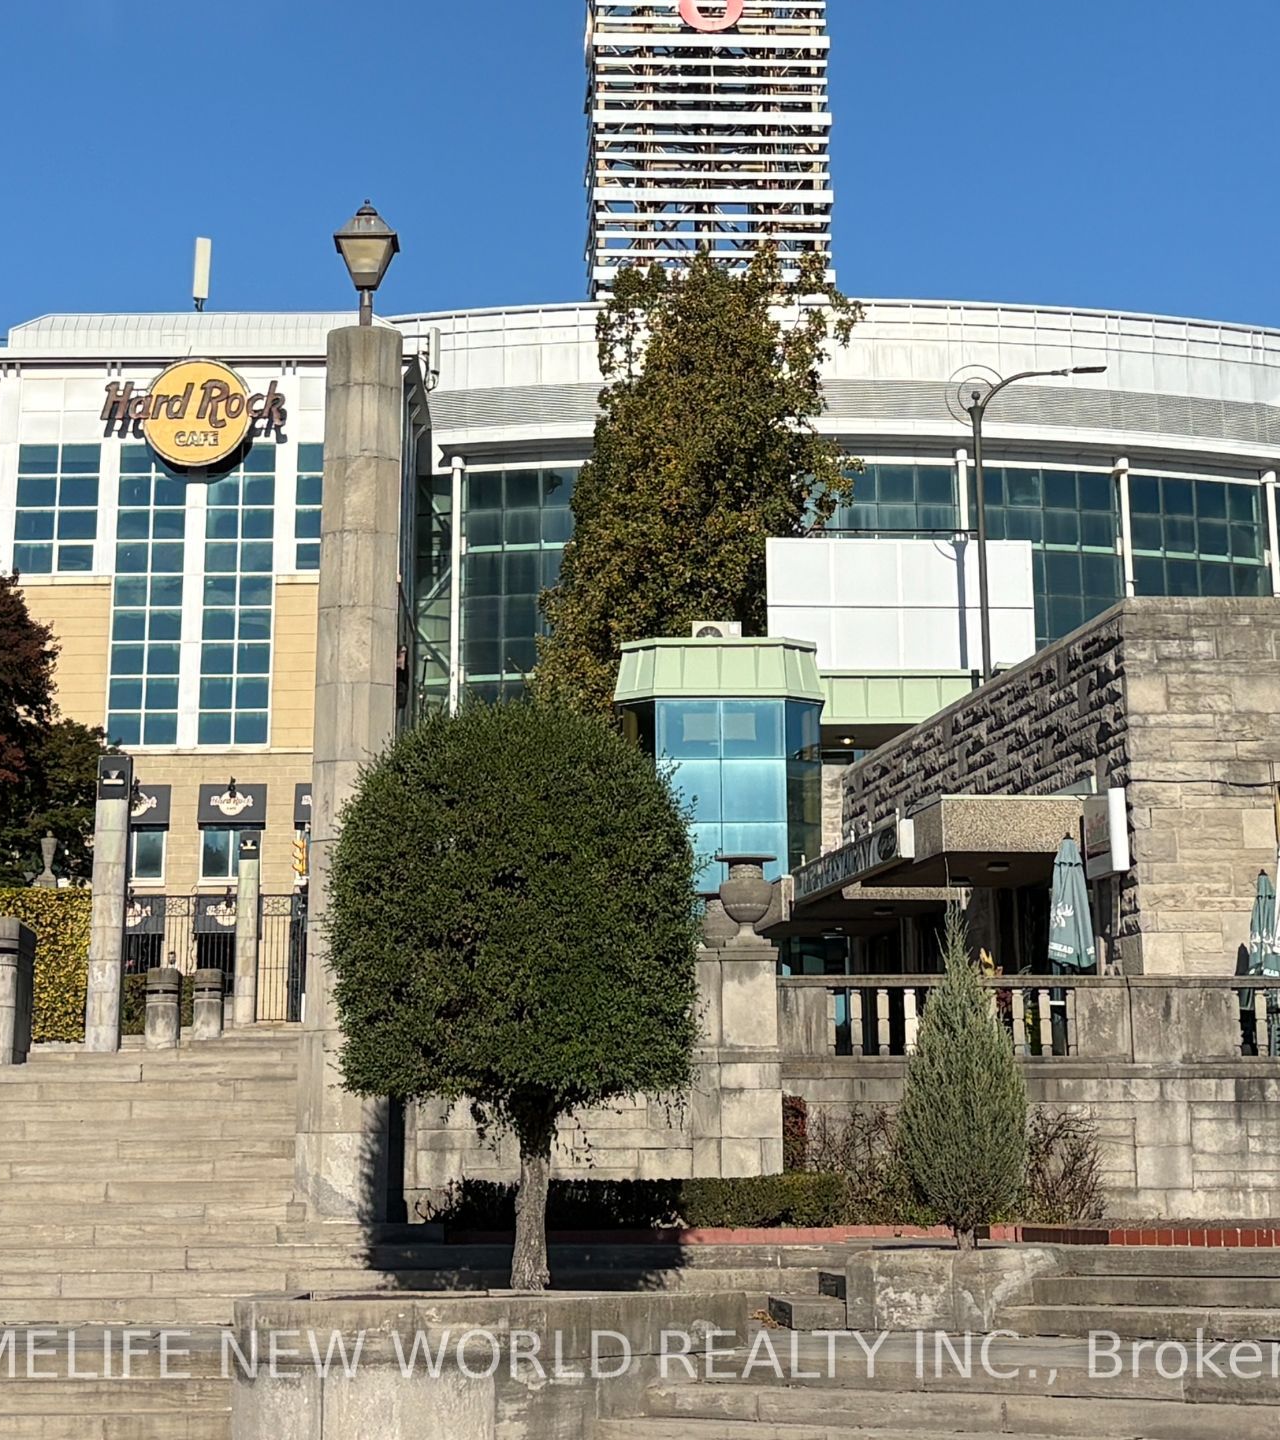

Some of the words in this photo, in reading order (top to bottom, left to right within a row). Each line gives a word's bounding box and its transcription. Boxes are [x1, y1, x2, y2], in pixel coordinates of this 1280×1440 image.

[100, 380, 195, 421] Hard
[196, 379, 287, 429] Rock
[174, 430, 220, 447] CAFE
